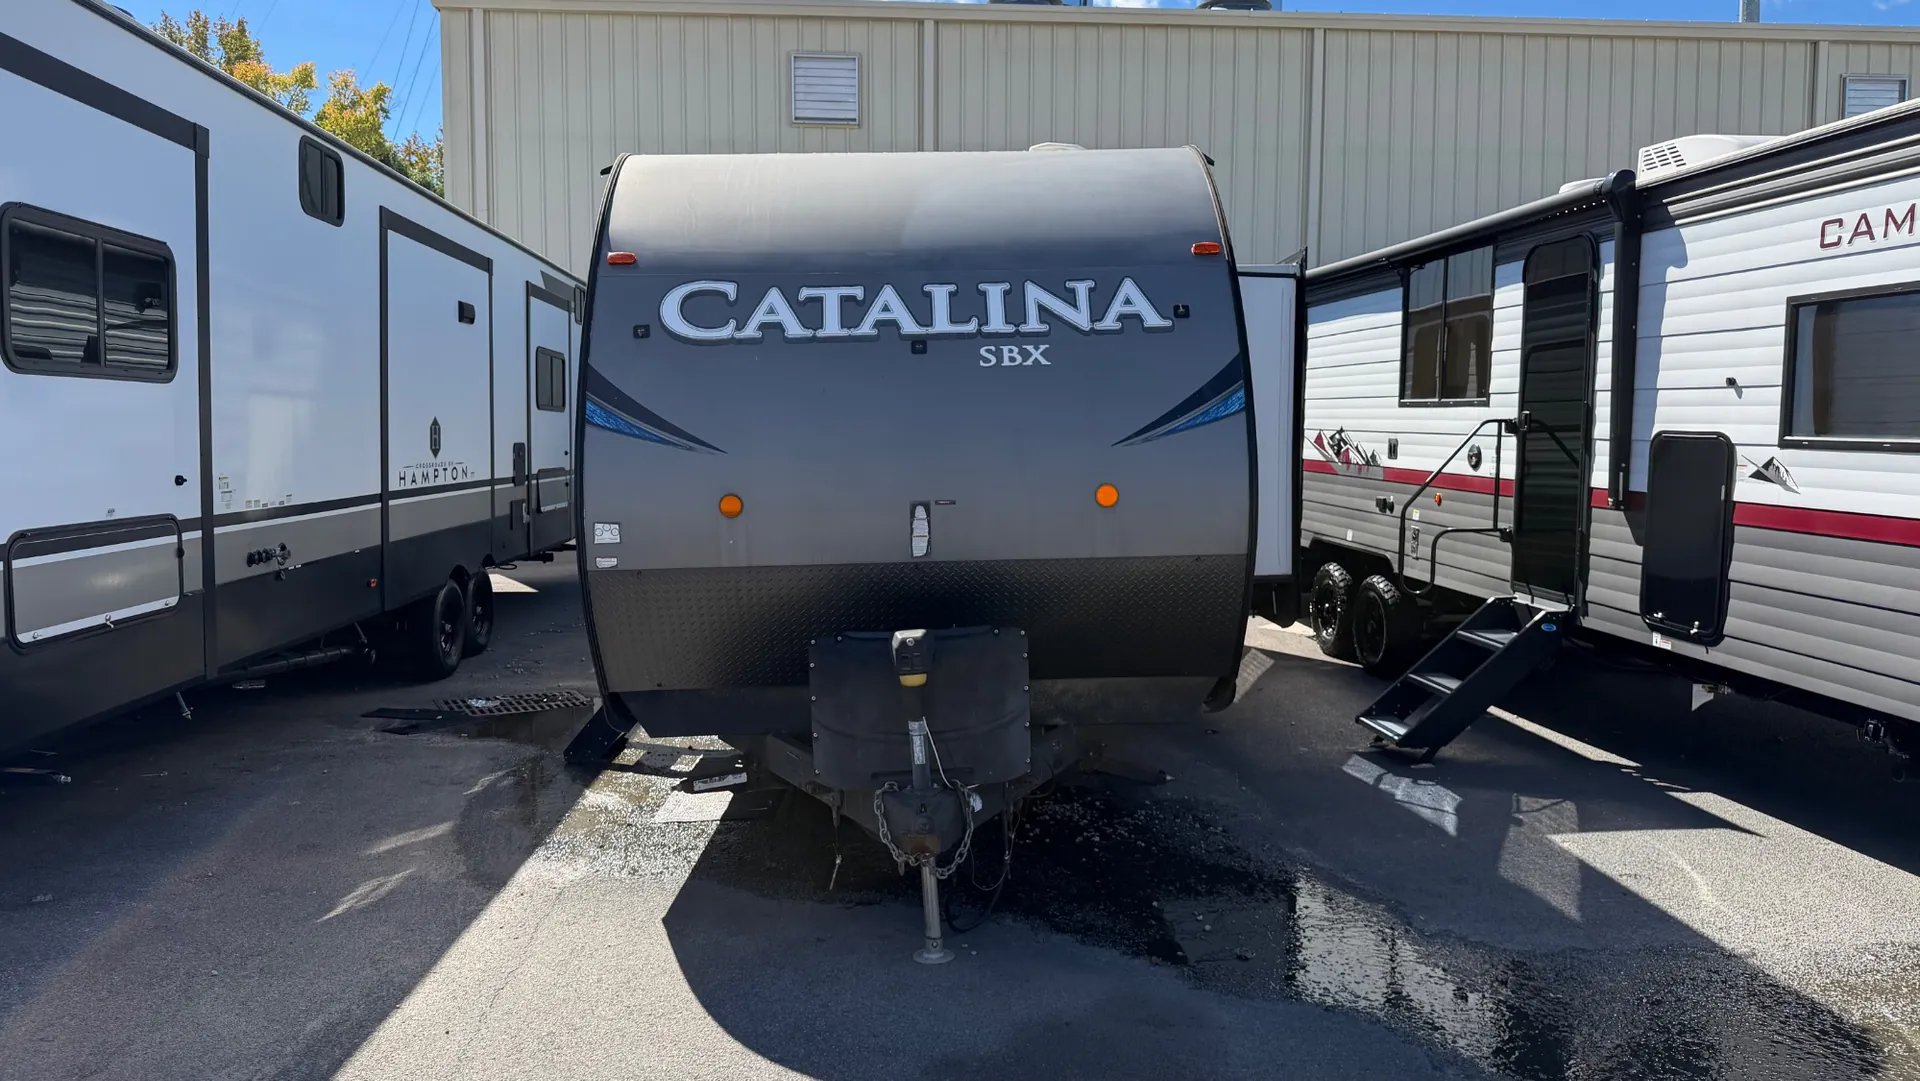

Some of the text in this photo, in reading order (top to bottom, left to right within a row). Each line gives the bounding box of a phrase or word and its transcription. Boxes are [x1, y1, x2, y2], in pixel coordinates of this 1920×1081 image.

[659, 277, 1173, 342] CATALINA
[979, 344, 1051, 367] SBX
[398, 465, 469, 487] HAMPTON
